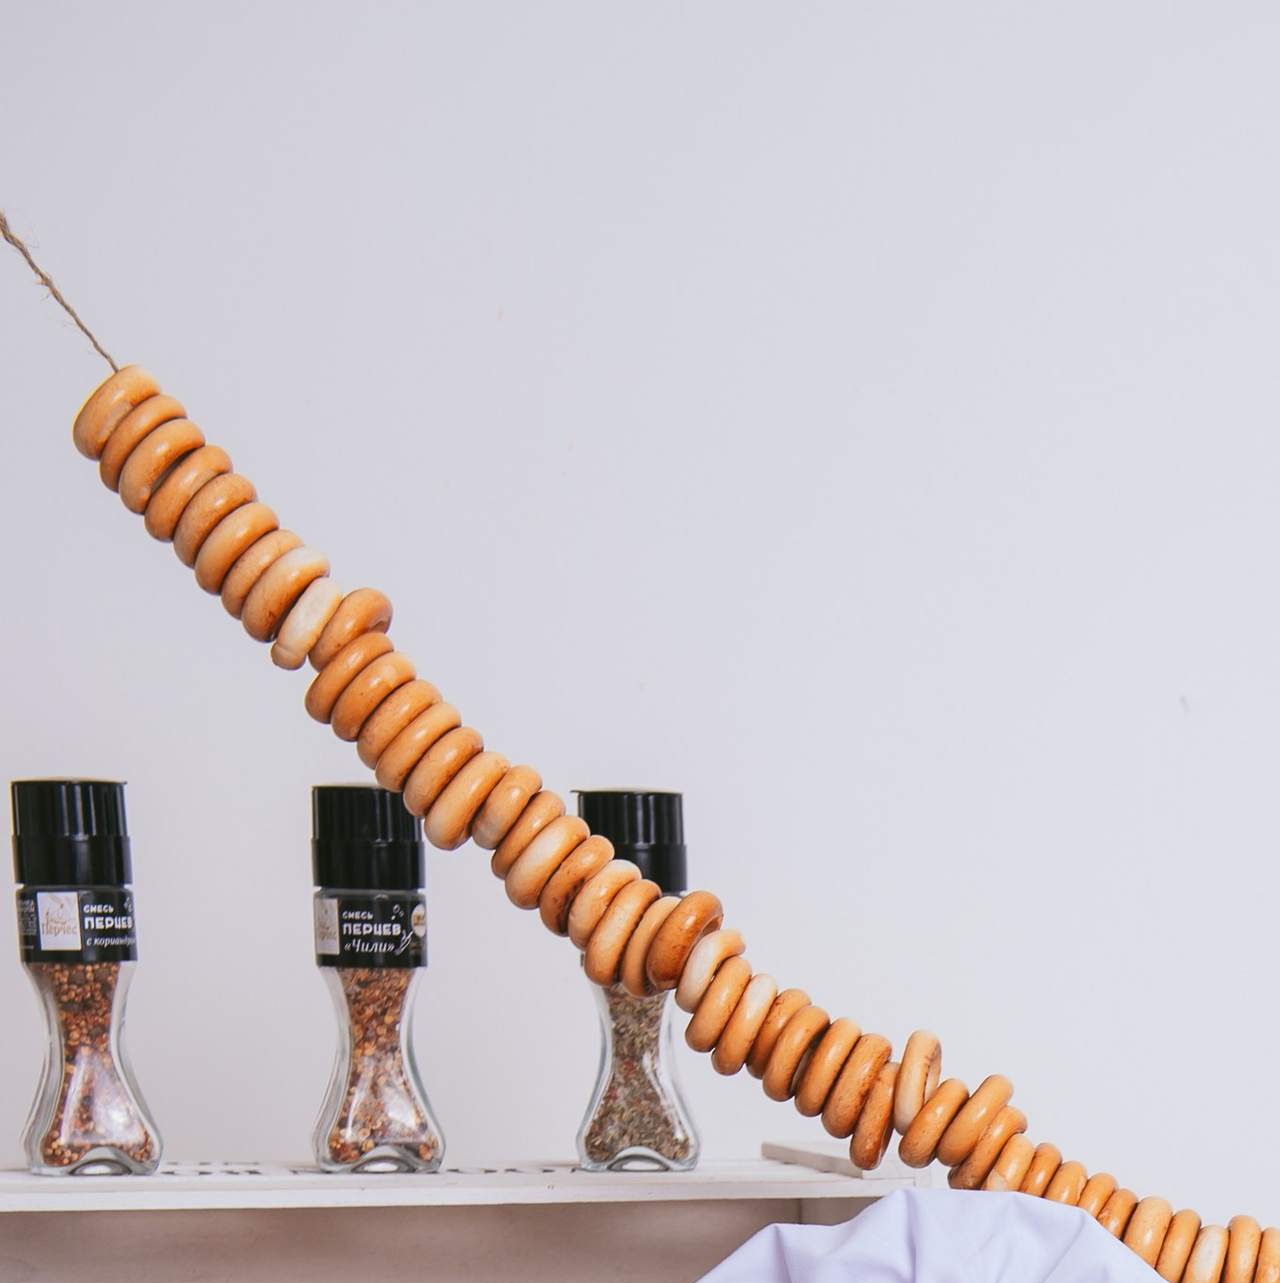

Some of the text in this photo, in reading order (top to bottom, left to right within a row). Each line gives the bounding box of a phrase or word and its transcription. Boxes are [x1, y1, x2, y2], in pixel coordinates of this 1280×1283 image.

[84, 916, 133, 930] ПЕРЦЕВ
[342, 911, 374, 921] СМЕСЬ
[343, 922, 402, 936] ПЕРЦЕВ
[345, 938, 396, 954] «Чили»
